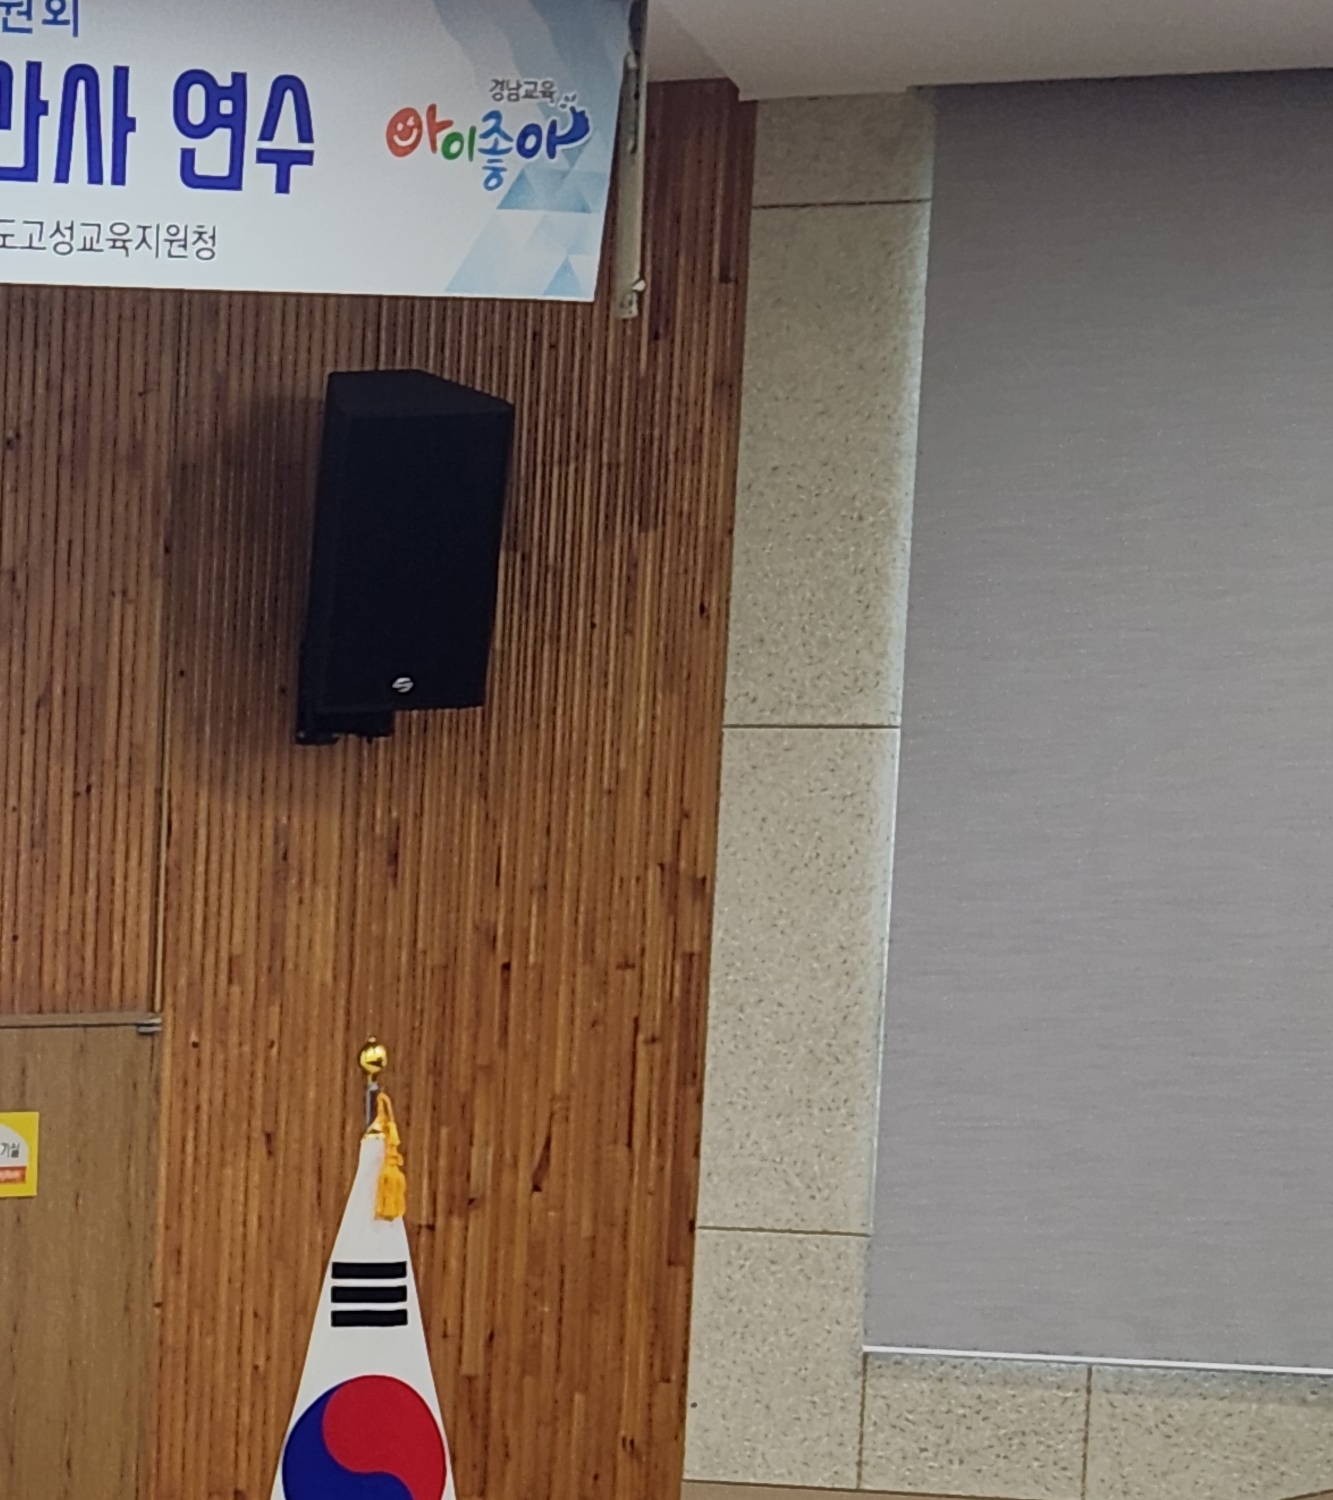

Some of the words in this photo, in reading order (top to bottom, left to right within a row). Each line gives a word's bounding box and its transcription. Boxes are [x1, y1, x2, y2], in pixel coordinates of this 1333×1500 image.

[172, 69, 315, 195] 연수
[489, 78, 556, 103] 경남교육
[386, 103, 590, 191] 아이좋아
